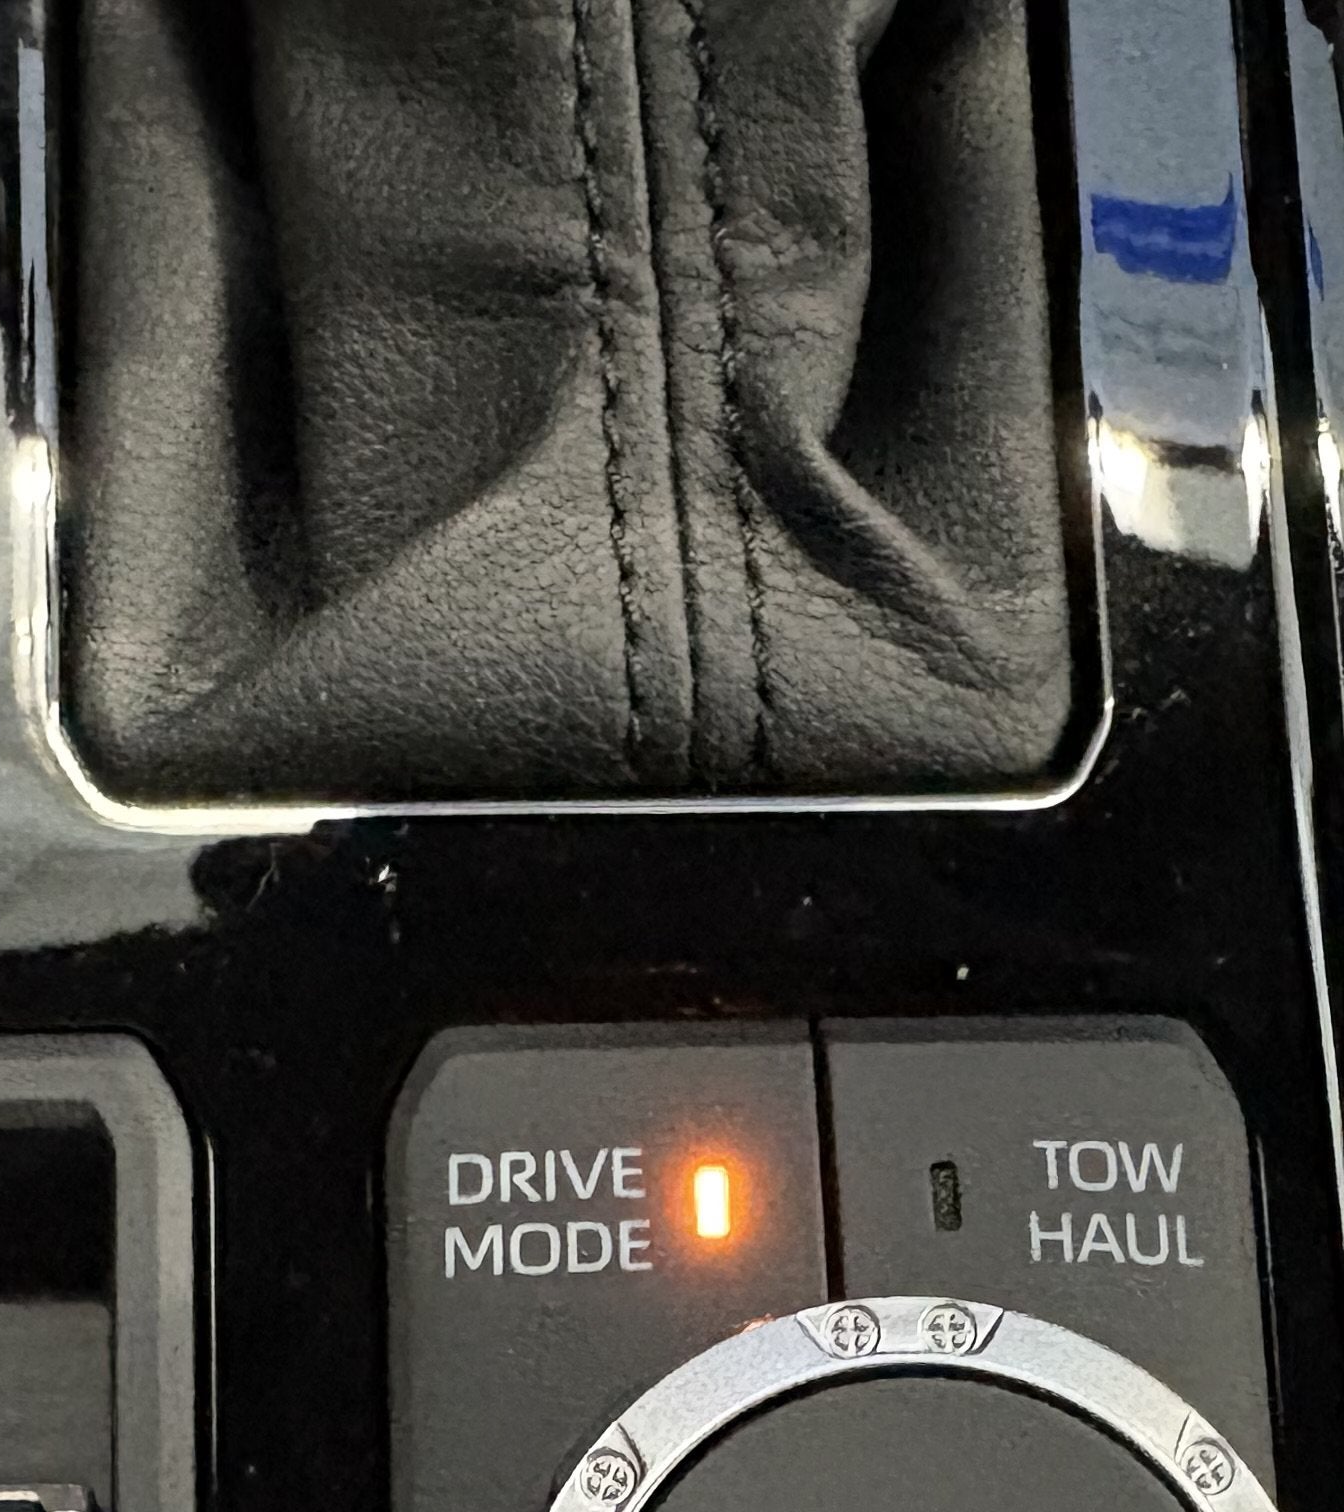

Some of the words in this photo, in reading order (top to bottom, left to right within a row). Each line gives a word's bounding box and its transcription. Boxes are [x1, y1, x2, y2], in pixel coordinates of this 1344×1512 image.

[446, 1146, 647, 1206] DRIVE
[1032, 1138, 1184, 1194] TOW
[443, 1218, 654, 1278] MODE
[1028, 1209, 1205, 1269] HAUL
